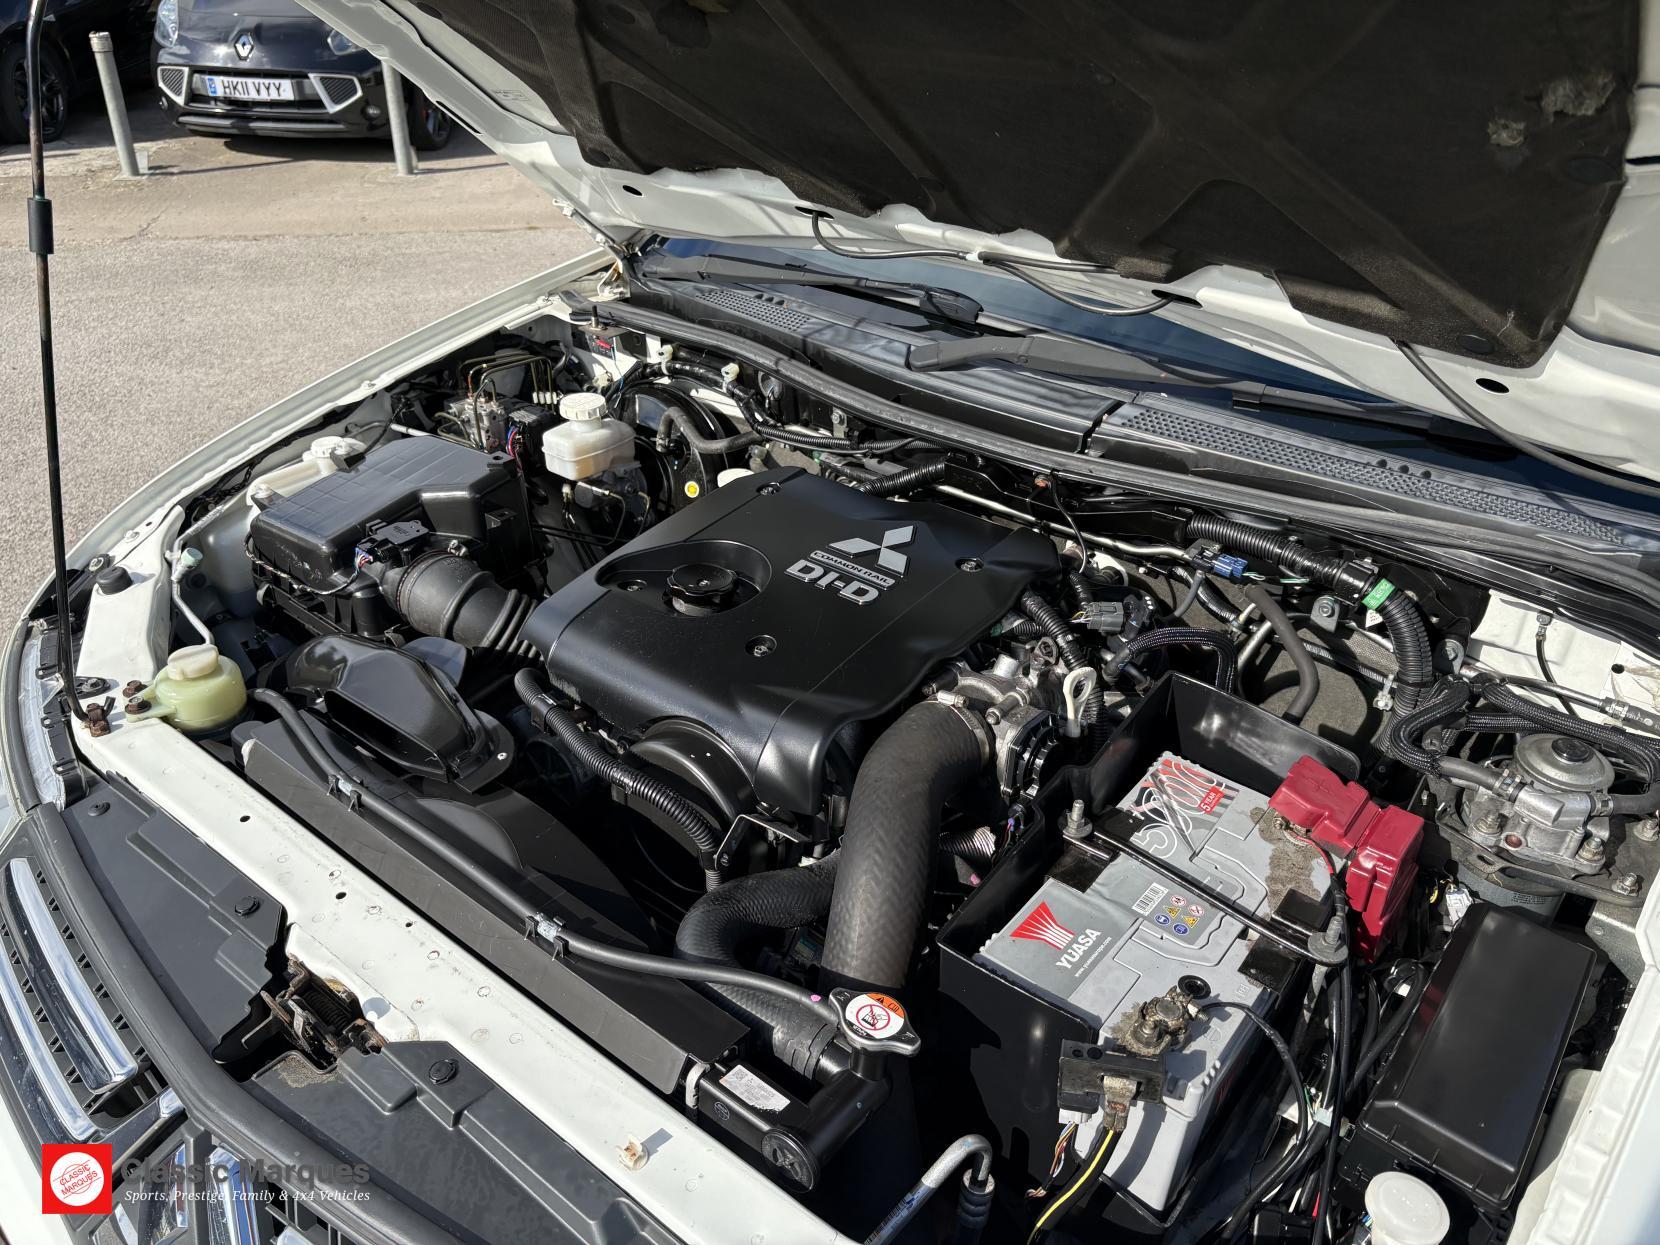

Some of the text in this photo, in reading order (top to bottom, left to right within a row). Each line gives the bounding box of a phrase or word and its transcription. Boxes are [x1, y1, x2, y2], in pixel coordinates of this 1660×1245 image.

[252, 80, 282, 97] VYY
[814, 551, 892, 585] COMMON RAIL
[784, 559, 879, 604] DI-D
[1200, 803, 1211, 812] 5
[1205, 791, 1217, 805] YEAR
[1056, 928, 1102, 970] YUASA
